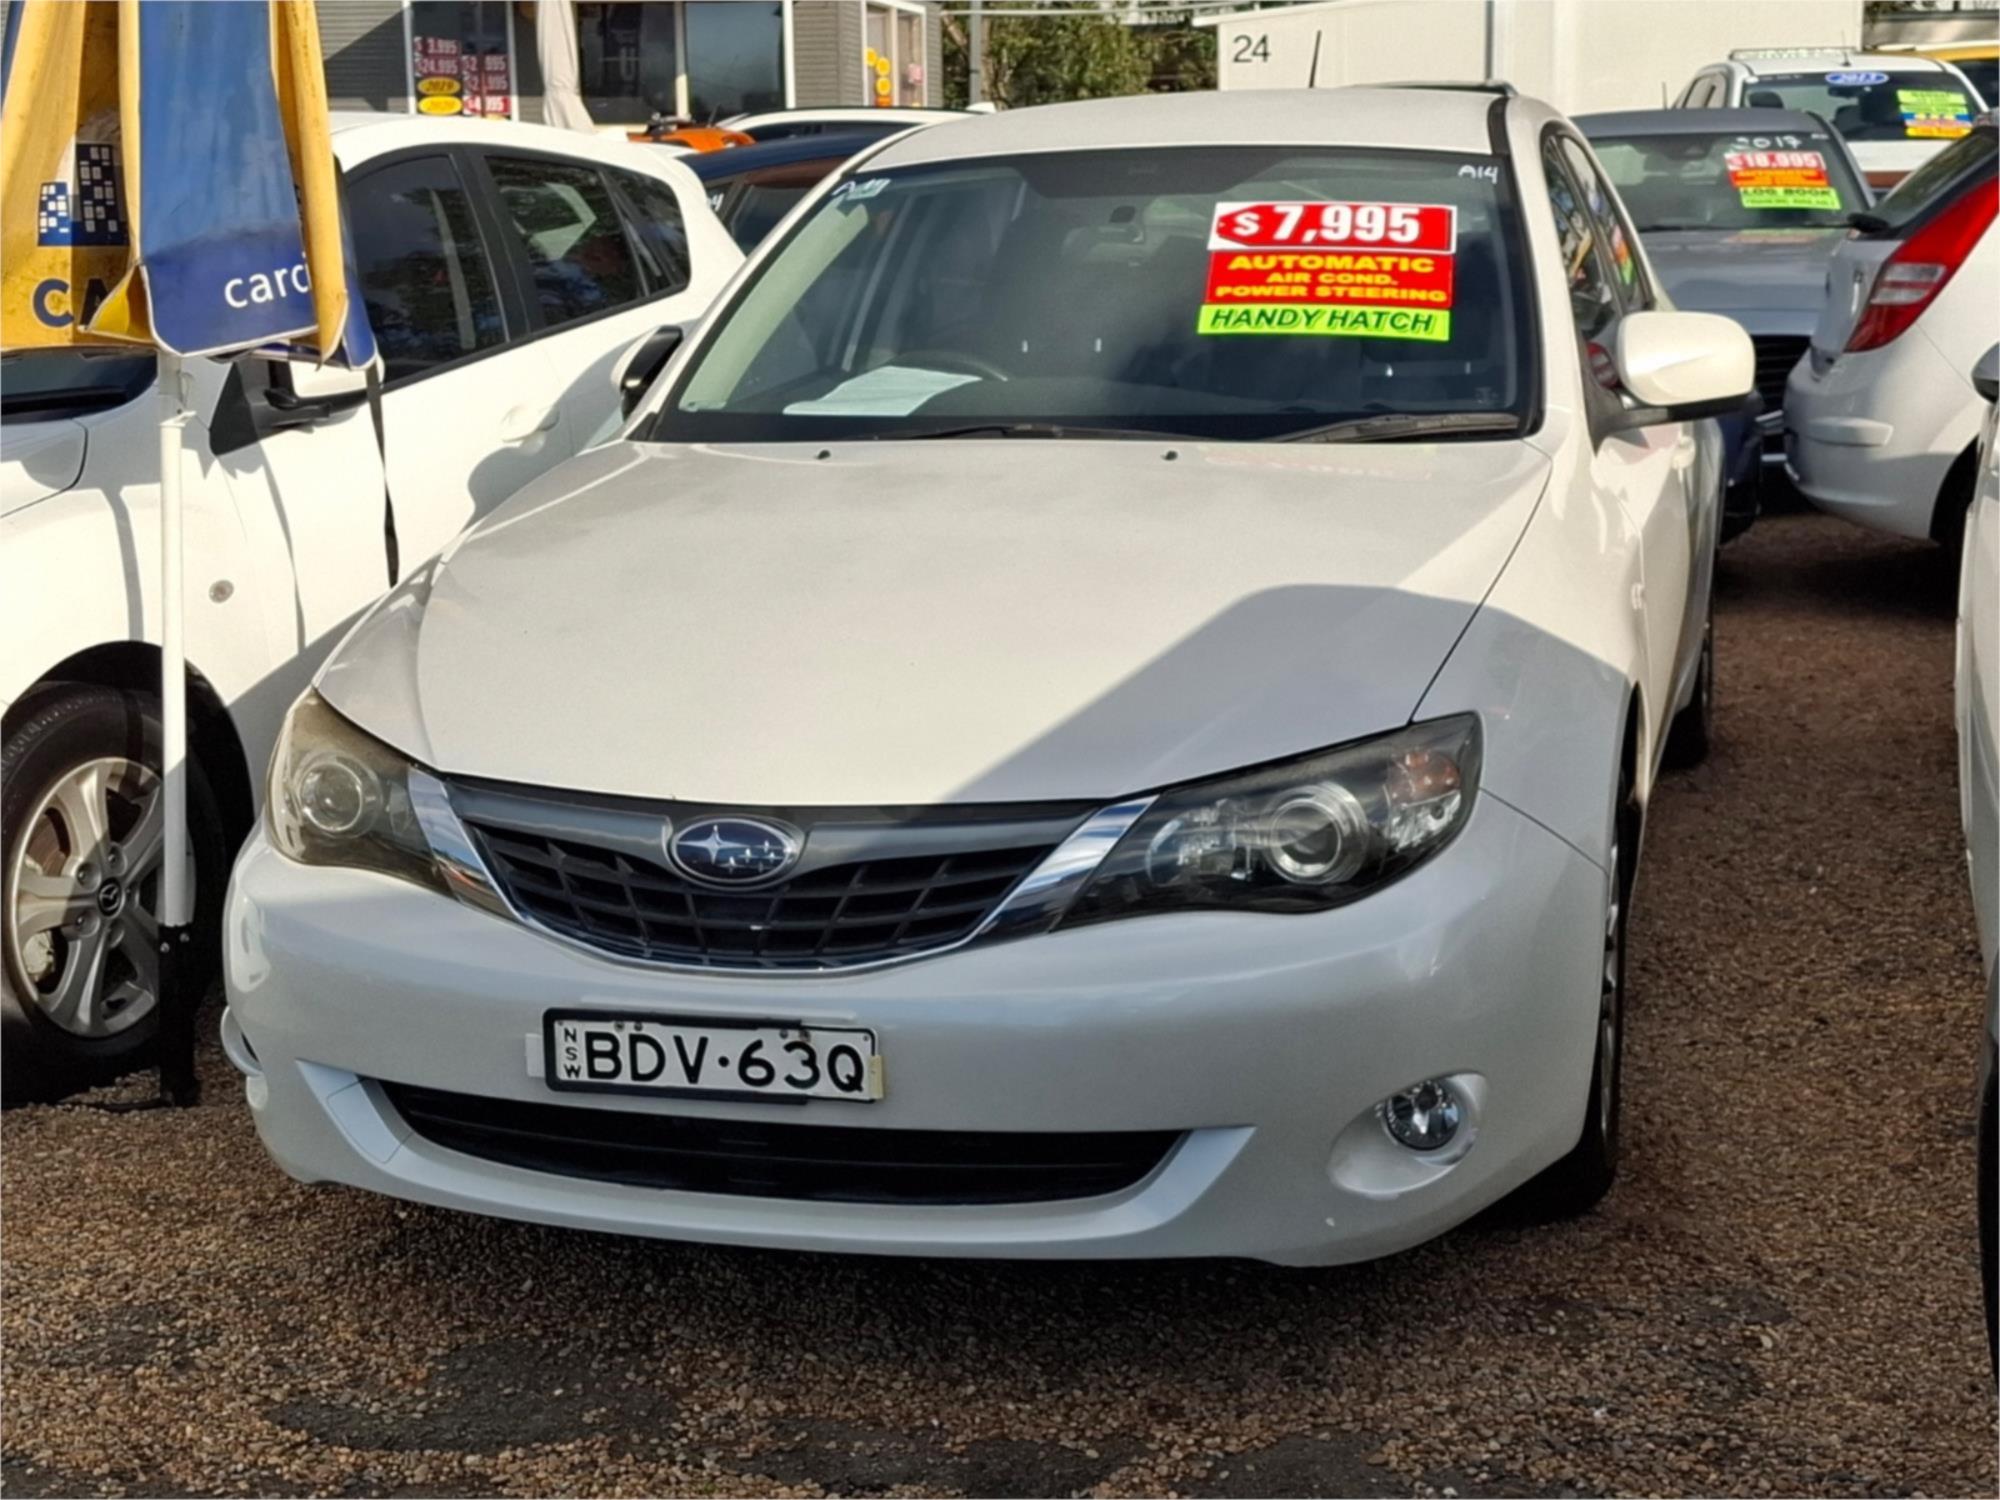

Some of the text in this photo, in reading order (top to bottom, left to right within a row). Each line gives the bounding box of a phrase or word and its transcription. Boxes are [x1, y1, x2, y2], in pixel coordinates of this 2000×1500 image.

[1233, 34, 1271, 62] 24
[1730, 135, 1802, 150] 2017
[1458, 164, 1498, 184] A14
[1272, 205, 1421, 242] 7,995
[1227, 255, 1435, 272] AUTOMATIC
[1266, 272, 1398, 285] AIR COND.
[1215, 286, 1447, 302] POWER STEERING
[1210, 309, 1436, 332] HANDY HATCH
[563, 1028, 581, 1079] NSW
